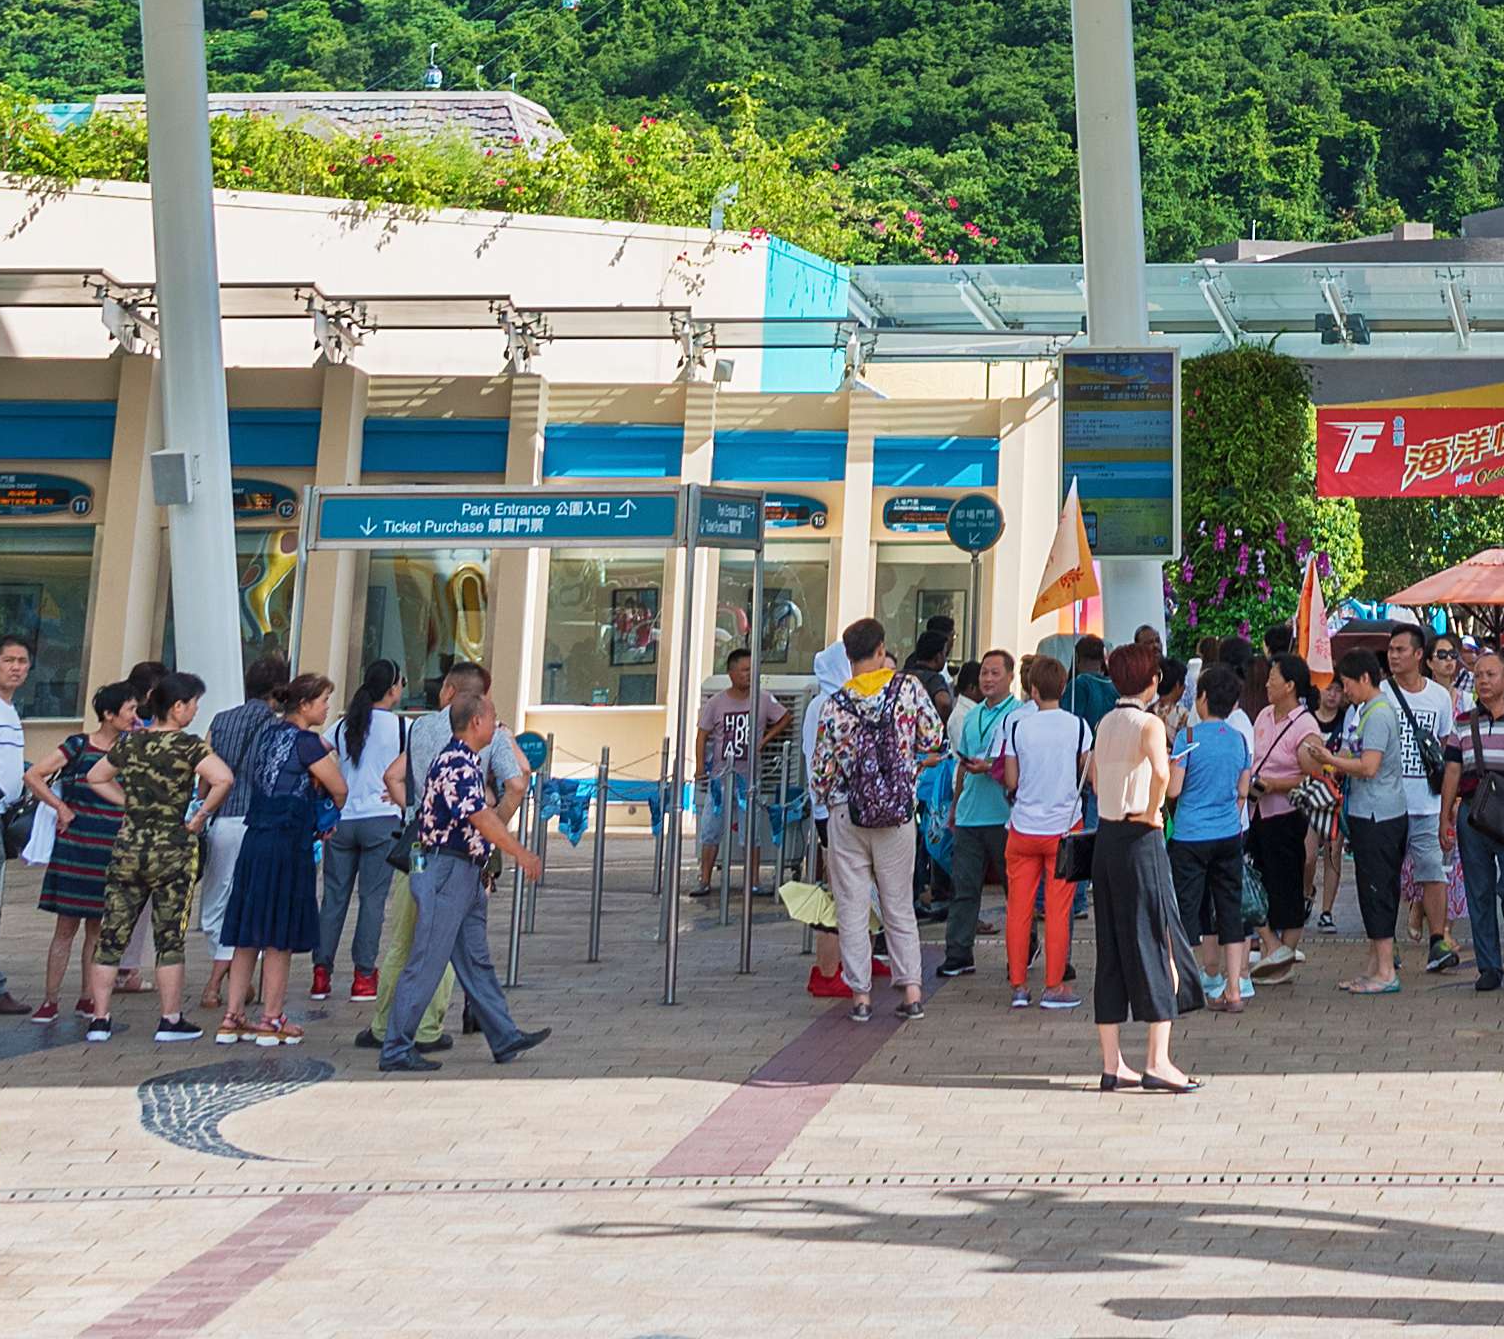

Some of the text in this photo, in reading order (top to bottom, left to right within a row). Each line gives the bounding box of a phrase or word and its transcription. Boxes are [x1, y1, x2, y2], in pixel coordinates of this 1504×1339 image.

[75, 501, 86, 512] 11
[281, 504, 293, 516] 12
[461, 501, 611, 517] Park Entrance 公園入口
[383, 517, 545, 534] Ticket Purchase 購買門票
[814, 516, 825, 526] 15
